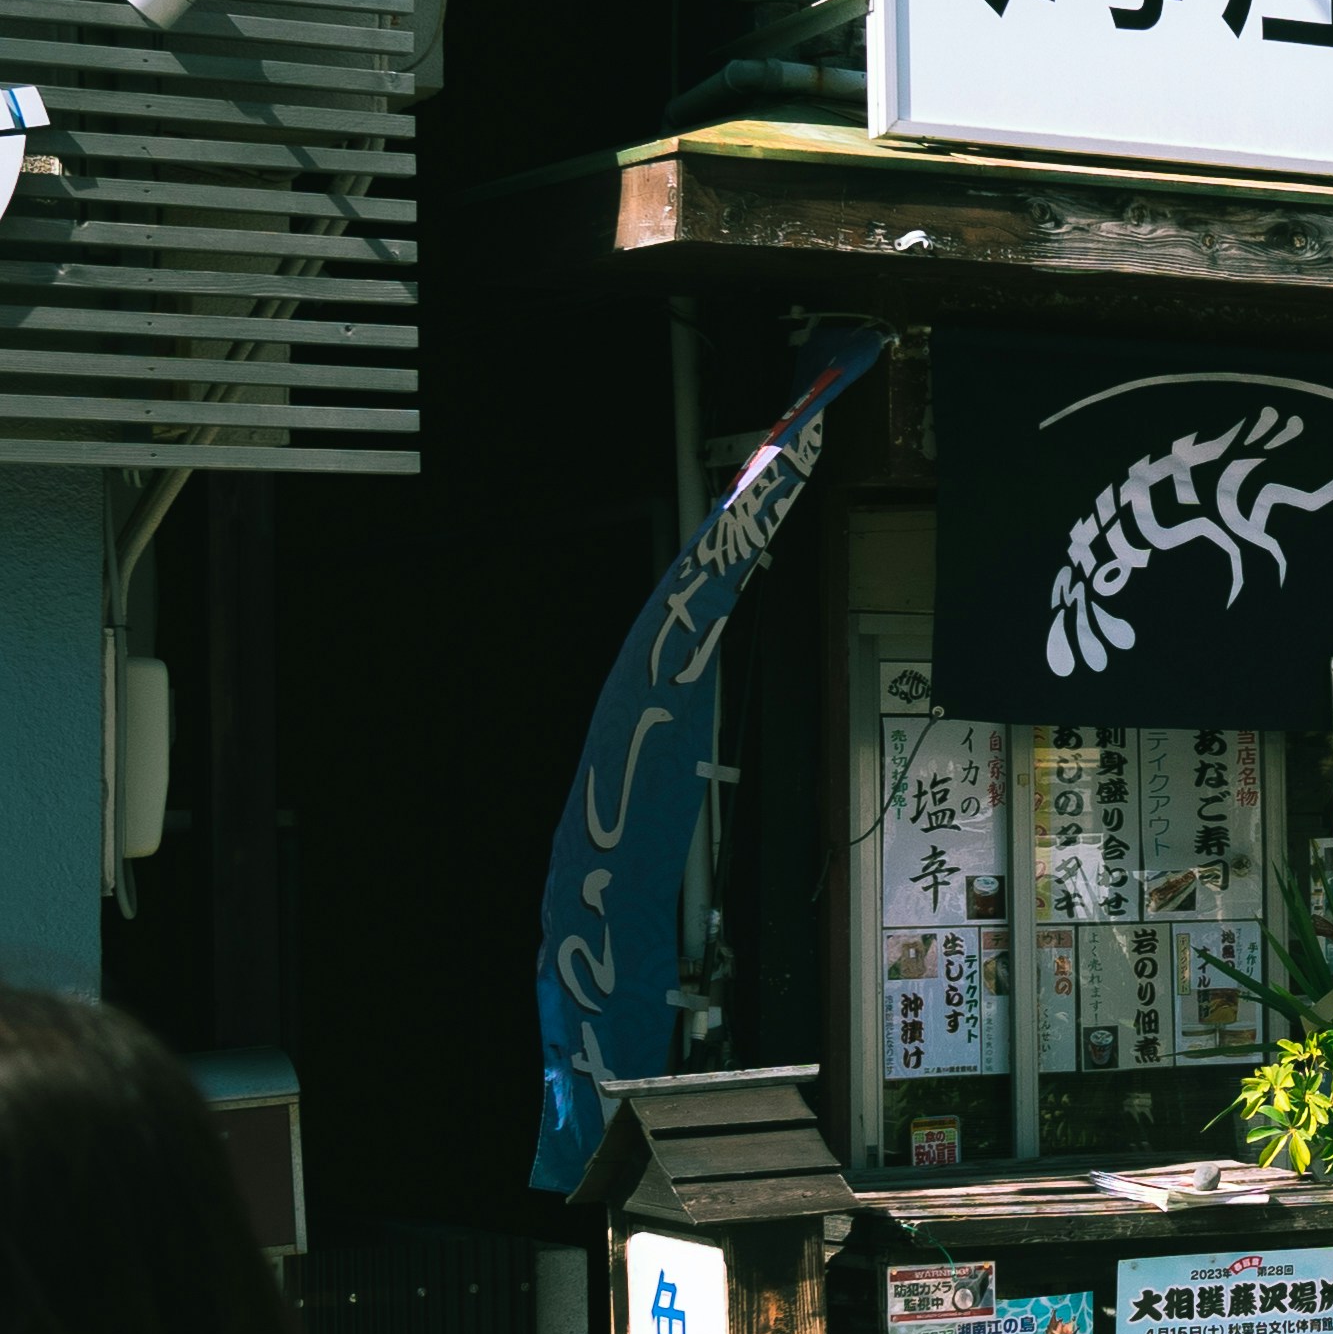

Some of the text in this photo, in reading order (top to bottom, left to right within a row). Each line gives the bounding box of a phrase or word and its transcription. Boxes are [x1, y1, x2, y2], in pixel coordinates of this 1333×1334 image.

[961, 727, 981, 817] イカの
[988, 730, 1006, 808] 自家製
[1194, 730, 1231, 892] あなご寿司
[942, 932, 965, 1034] 生しらす
[964, 954, 979, 1044] テイクアウト
[1190, 1267, 1233, 1281] 2023年
